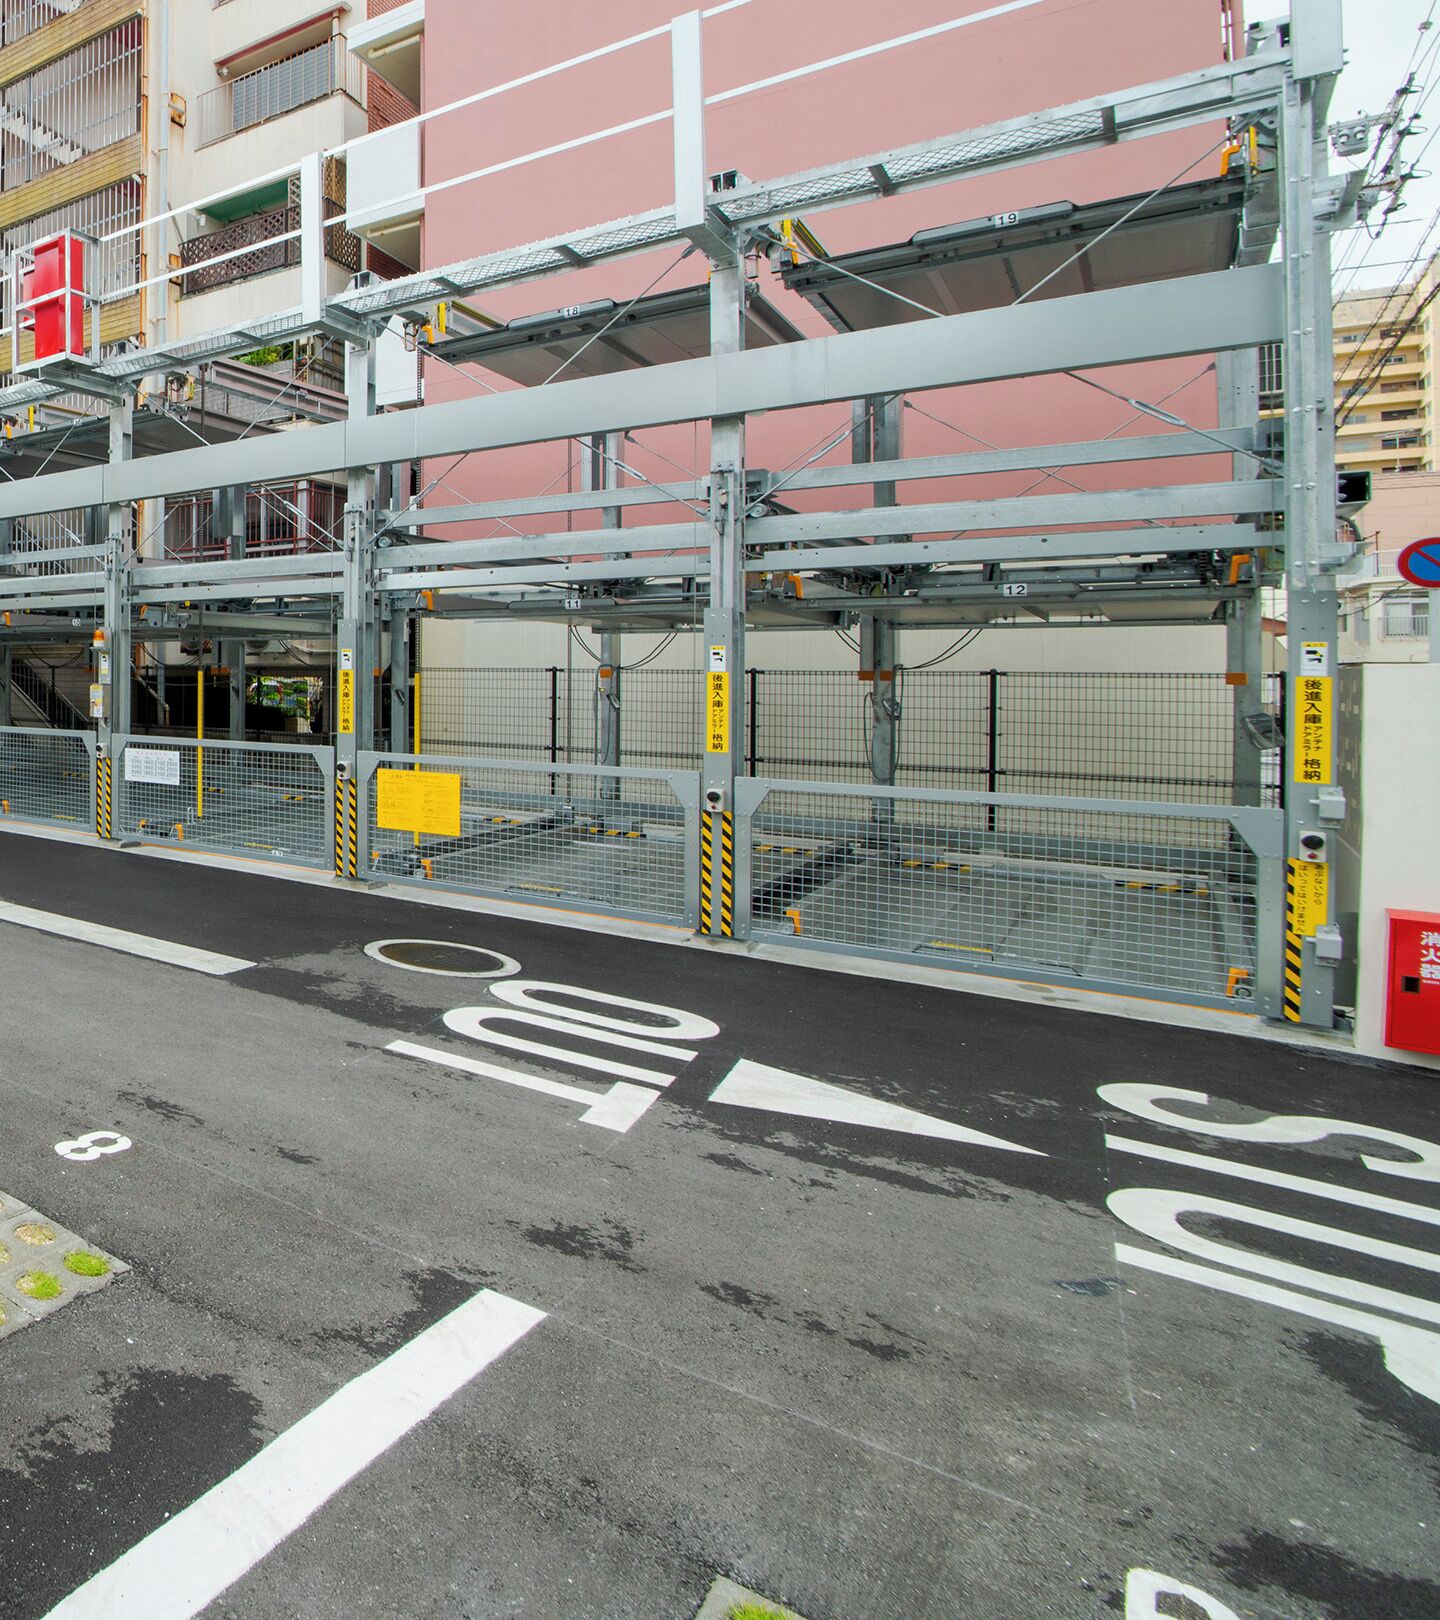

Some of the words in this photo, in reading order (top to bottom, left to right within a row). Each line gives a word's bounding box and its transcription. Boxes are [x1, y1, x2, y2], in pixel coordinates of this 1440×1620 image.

[998, 213, 1017, 225] 19
[566, 306, 579, 316] 18
[1006, 585, 1026, 595] 12
[567, 600, 579, 608] 11
[712, 673, 723, 708] 後進入庫
[1304, 679, 1323, 724] 後進入庫
[712, 733, 723, 750] 格納
[1303, 725, 1312, 757] ドアミラー
[1313, 725, 1323, 751] アンテナ
[1303, 758, 1321, 781] 格納
[385, 980, 720, 1133] OUT
[54, 1130, 133, 1161] 8
